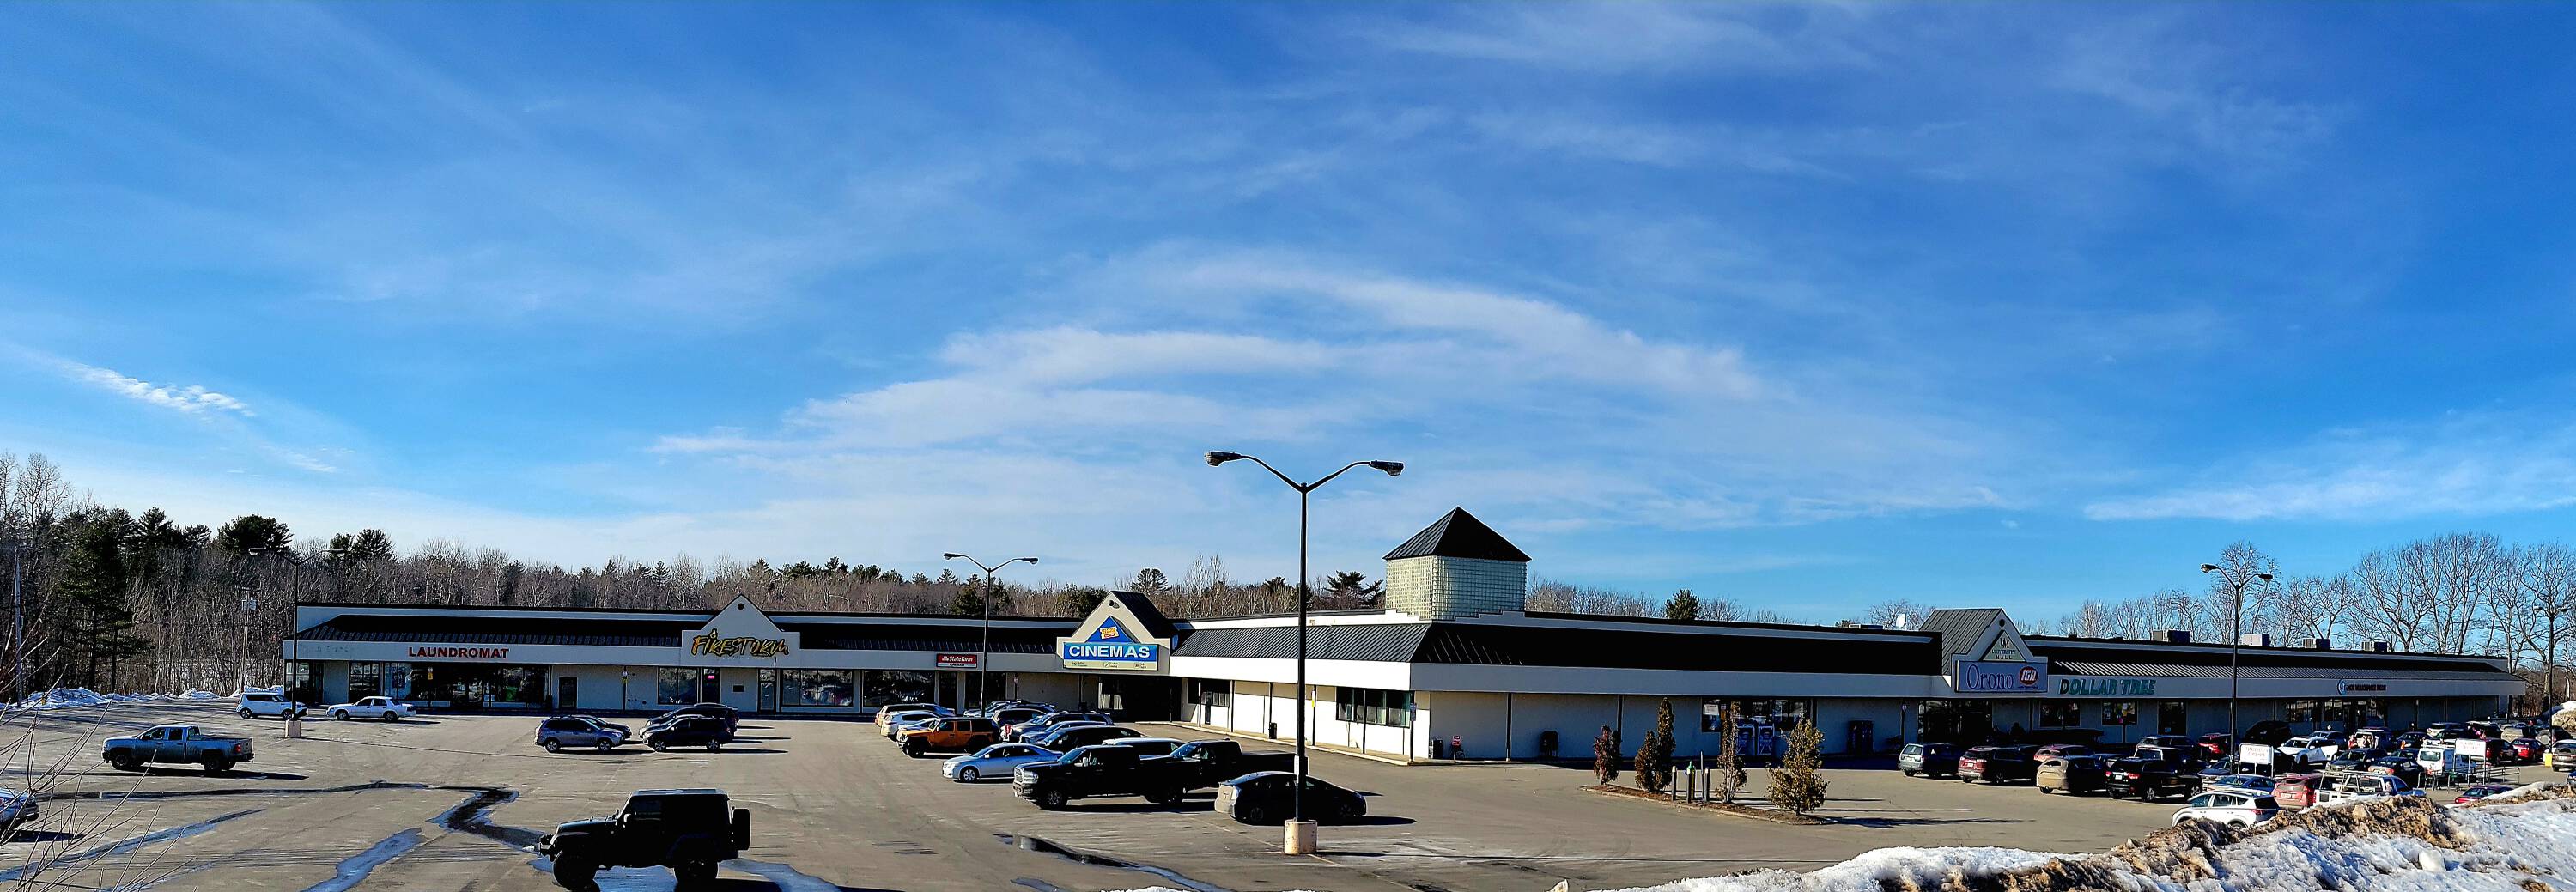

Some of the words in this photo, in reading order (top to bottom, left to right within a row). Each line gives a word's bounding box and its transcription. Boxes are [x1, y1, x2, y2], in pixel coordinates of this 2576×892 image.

[691, 628, 789, 657] FIRESTORM
[409, 646, 509, 658] LAUNDROMAT
[1069, 645, 1150, 658] CINEMAS
[1966, 664, 2014, 689] Orono
[2021, 670, 2036, 681] IGA
[2058, 678, 2118, 695] DOLLAR
[2120, 679, 2156, 695] TREE
